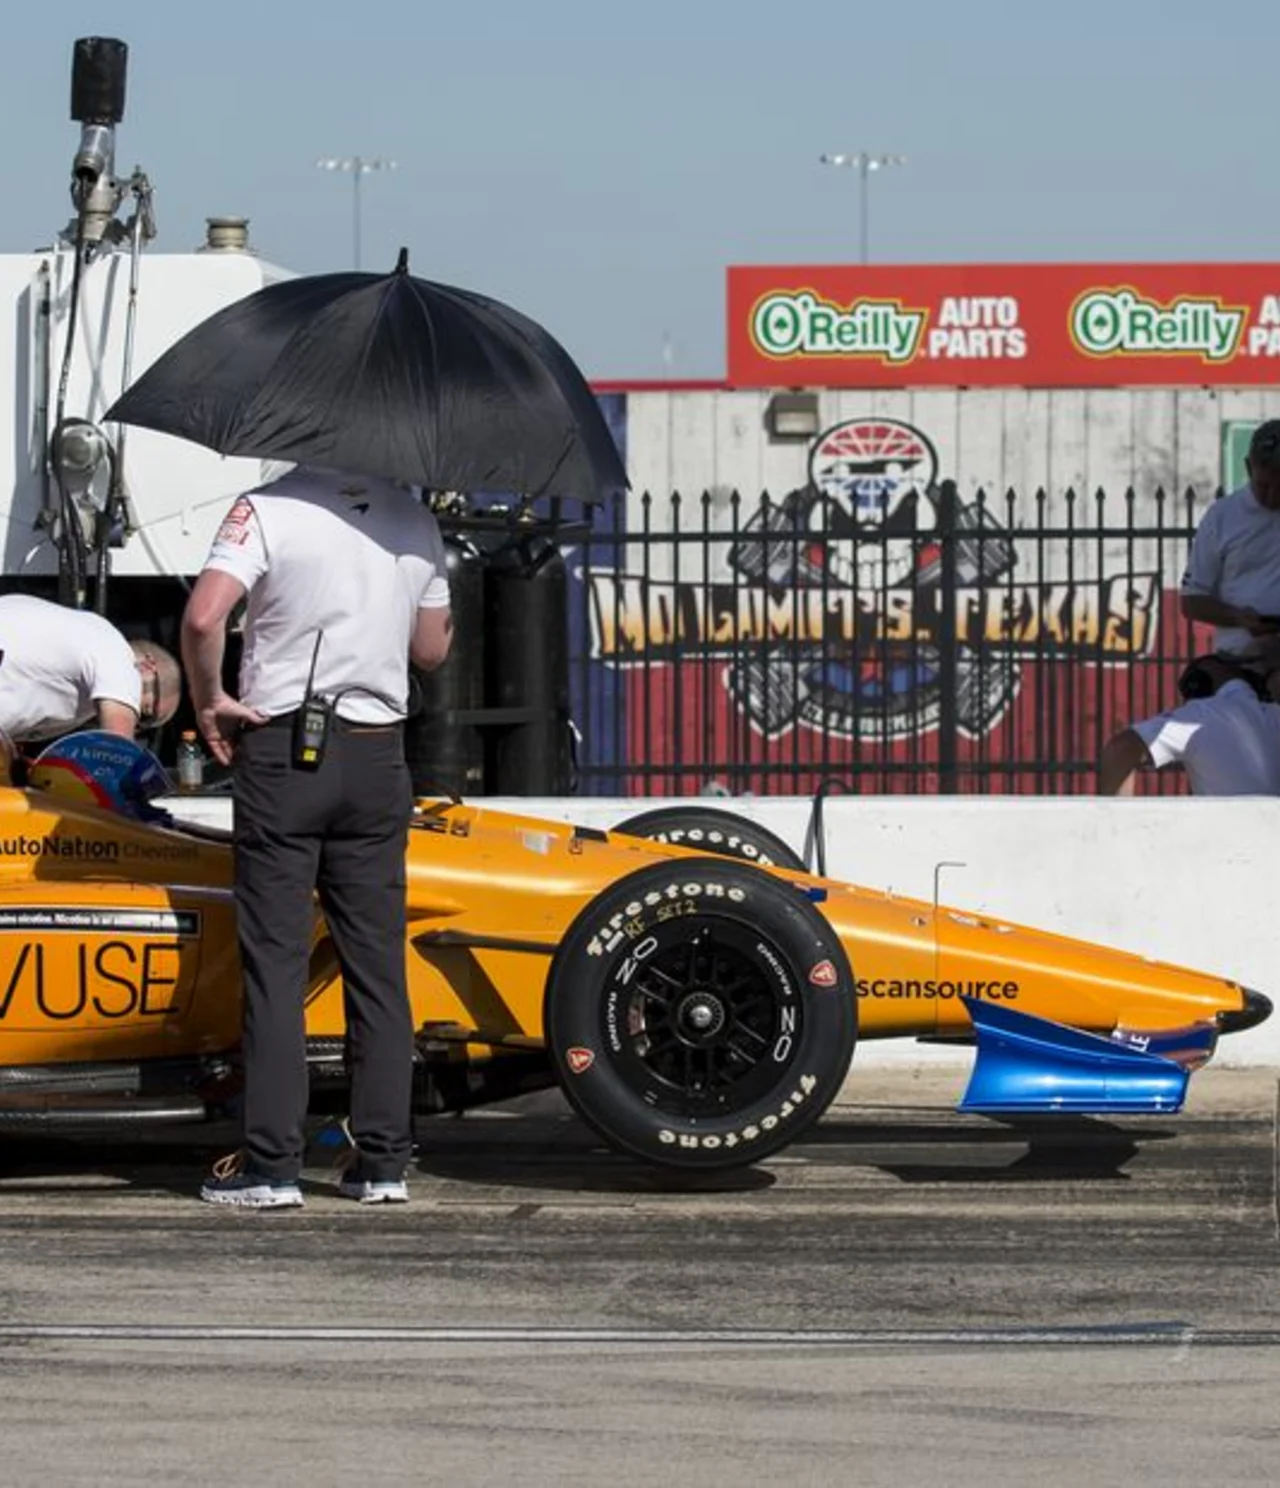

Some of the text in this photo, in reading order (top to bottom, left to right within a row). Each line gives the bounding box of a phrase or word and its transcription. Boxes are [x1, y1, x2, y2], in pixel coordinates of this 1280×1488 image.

[760, 297, 916, 354] O'Reilly
[939, 297, 1018, 327] AUTO
[1078, 295, 1236, 352] O'Reilly
[929, 328, 1027, 358] PARTS
[586, 882, 746, 956] Firestone
[656, 900, 683, 922] SET
[683, 899, 699, 915] 2
[856, 978, 1019, 999] scansource
[657, 1073, 818, 1149] Firestone
